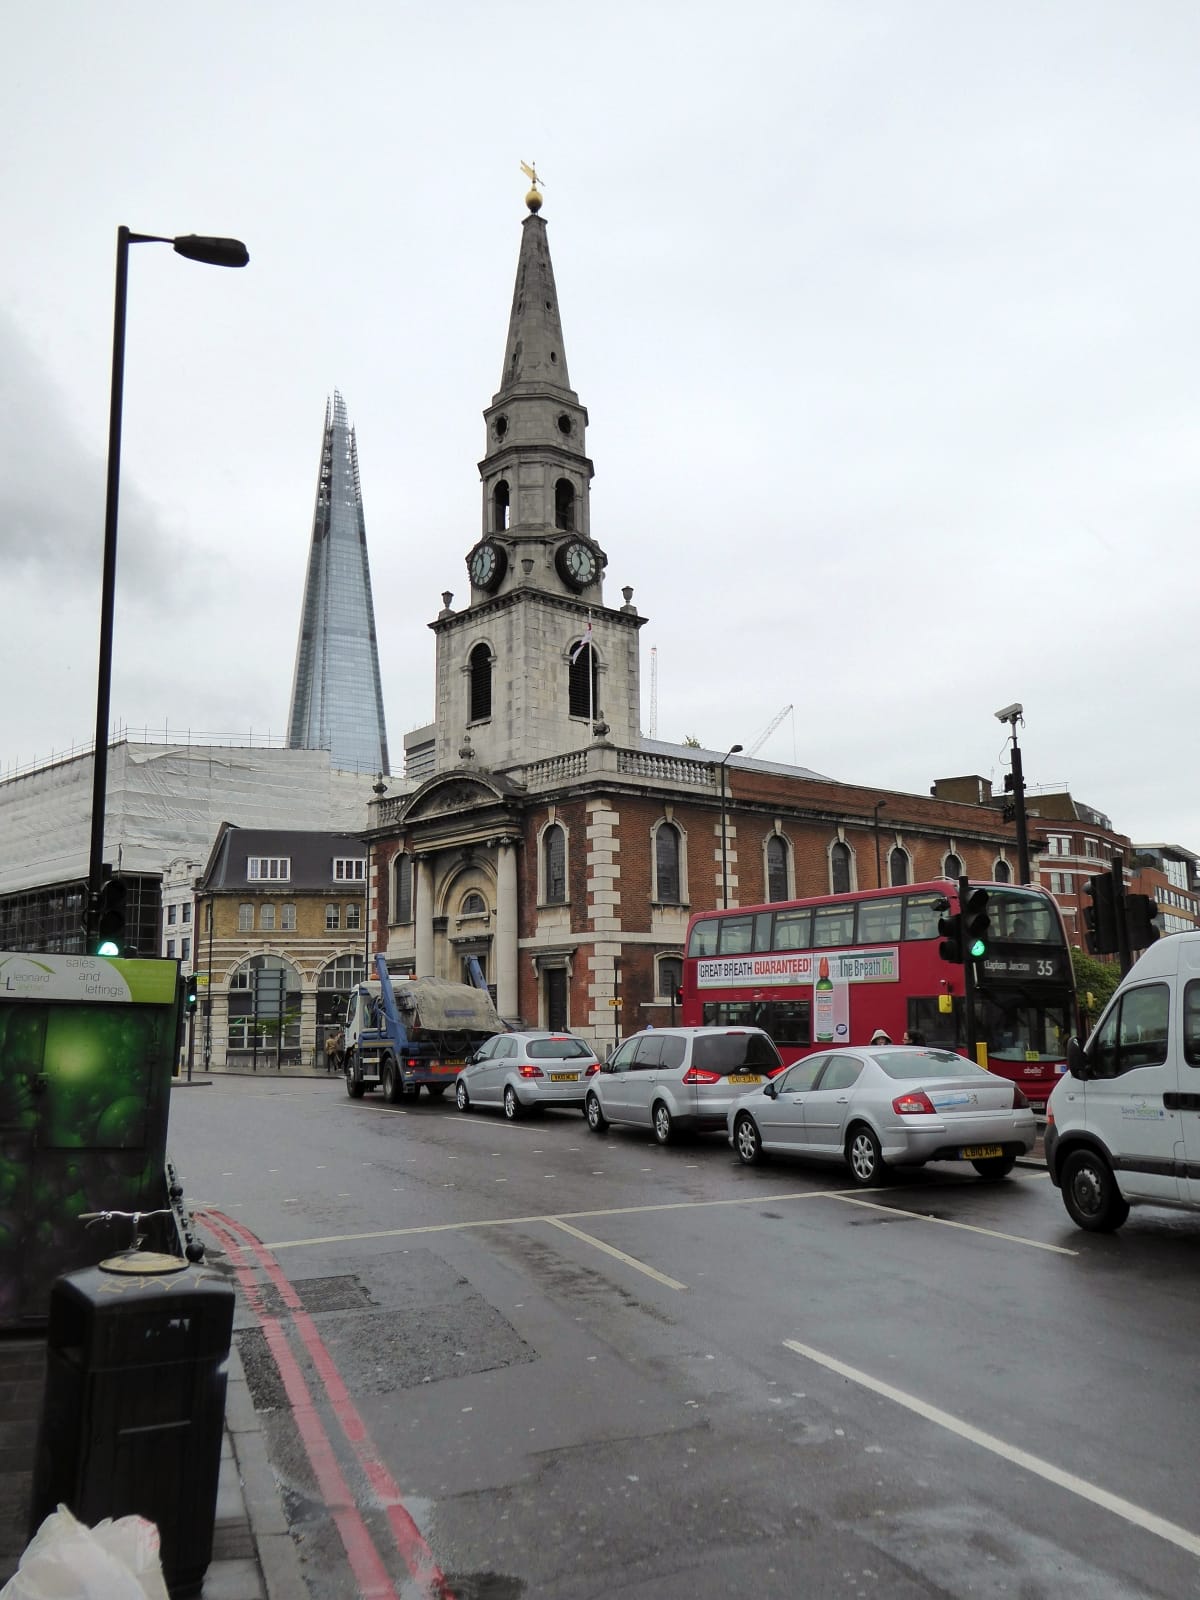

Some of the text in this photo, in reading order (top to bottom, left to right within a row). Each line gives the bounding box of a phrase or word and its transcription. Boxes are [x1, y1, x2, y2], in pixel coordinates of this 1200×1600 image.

[66, 957, 96, 969] sales
[700, 957, 812, 978] GREAT BREATH GUARANTEED!
[840, 957, 893, 977] The Breath Co
[1036, 960, 1053, 976] 35
[79, 971, 101, 982] and
[85, 983, 124, 996] lettings
